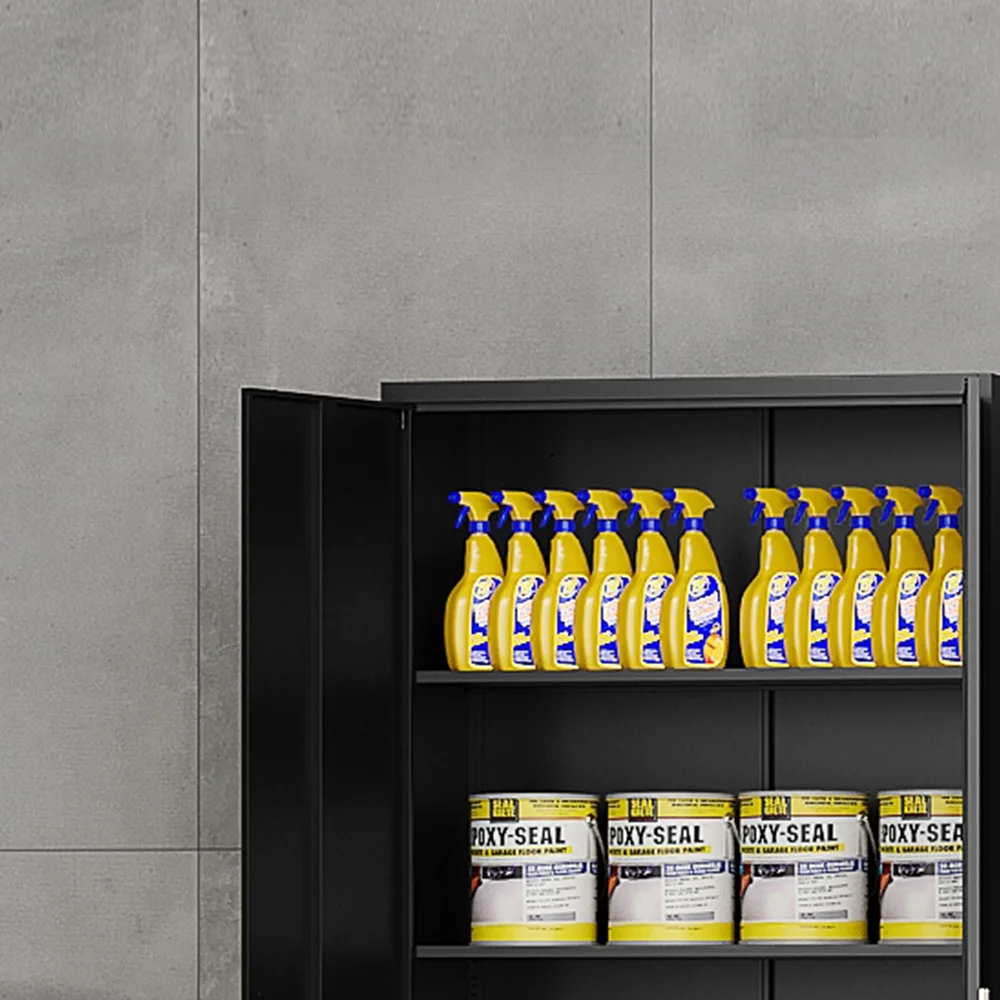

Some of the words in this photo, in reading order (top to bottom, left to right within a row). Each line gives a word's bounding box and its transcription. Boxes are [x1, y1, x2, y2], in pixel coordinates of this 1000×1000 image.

[471, 825, 566, 846] POXY-SEAL
[609, 825, 705, 846] POXY-SEAL
[742, 823, 838, 843] POXY-SEAL
